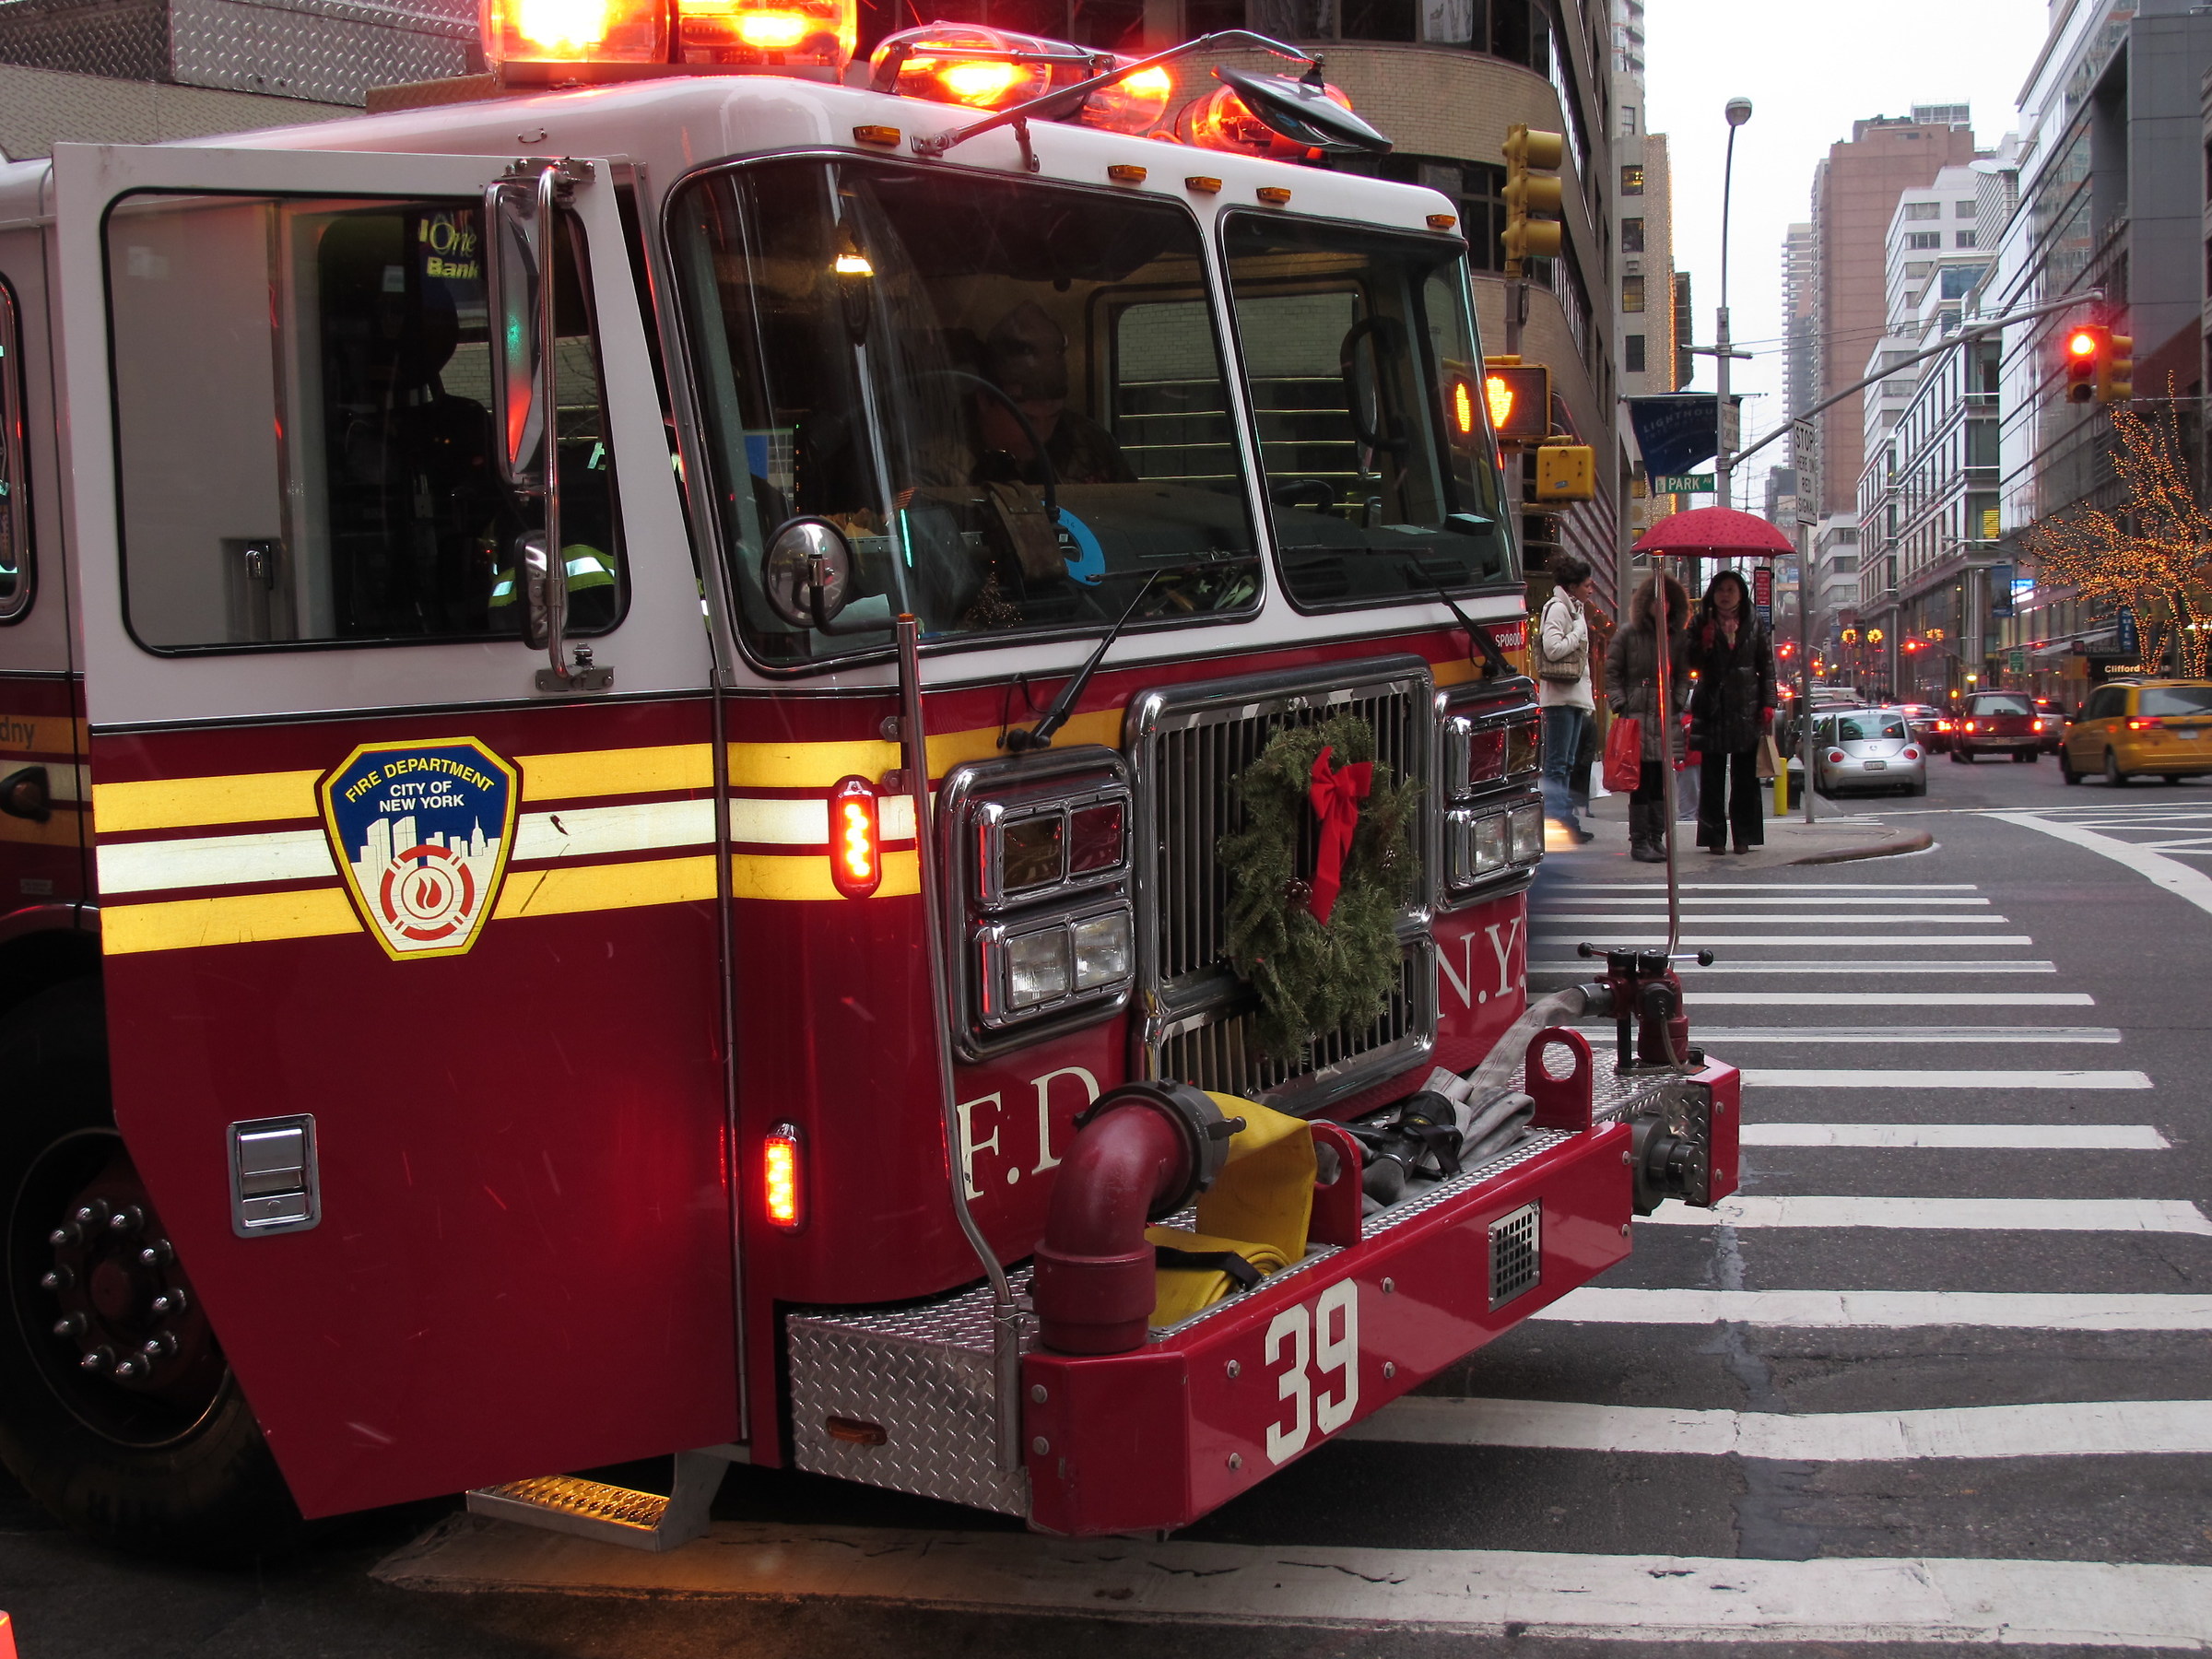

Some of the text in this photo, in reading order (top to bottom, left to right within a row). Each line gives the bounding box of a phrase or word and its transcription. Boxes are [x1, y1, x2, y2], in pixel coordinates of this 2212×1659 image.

[427, 256, 478, 278] Bank
[1643, 408, 1713, 433] LIGHTHOU
[1795, 426, 1814, 453] STOP
[1668, 477, 1700, 490] PARK
[2104, 665, 2141, 674] Clifford
[345, 758, 495, 803] FIRE DEPARTMENT
[390, 781, 453, 797] CITY OF
[379, 794, 465, 813] NEW YORK
[1265, 1277, 1359, 1466] 39
